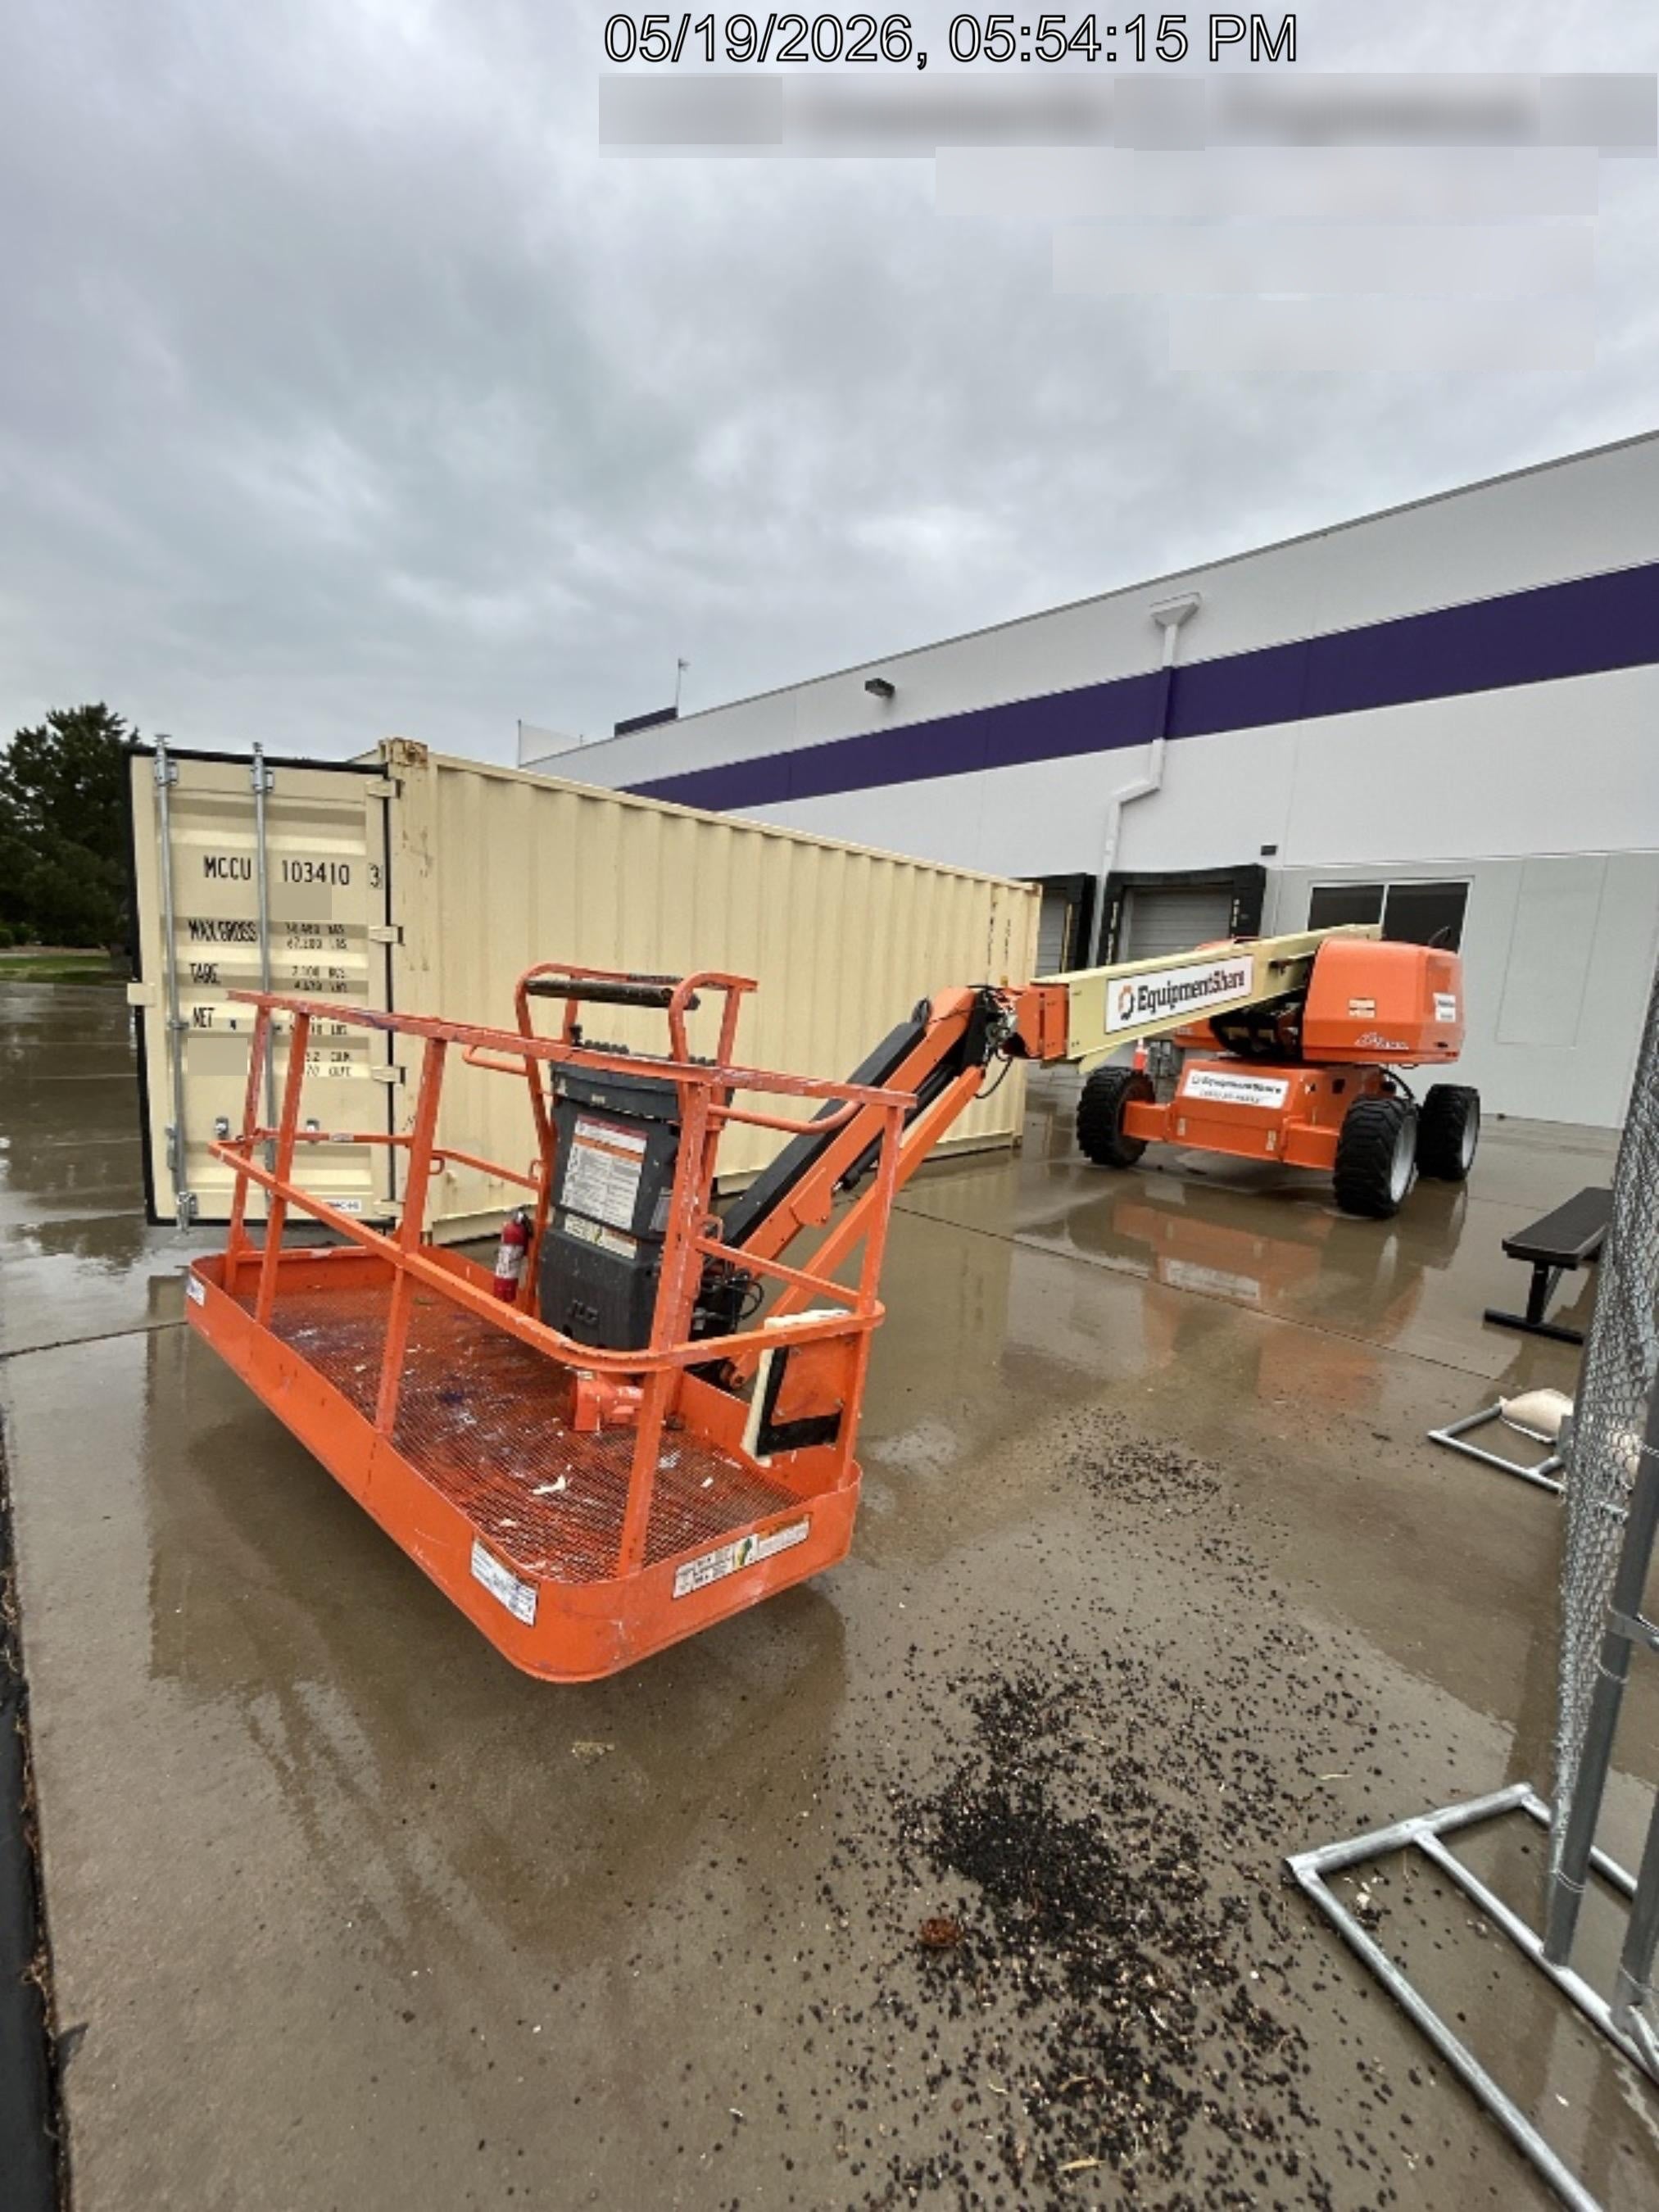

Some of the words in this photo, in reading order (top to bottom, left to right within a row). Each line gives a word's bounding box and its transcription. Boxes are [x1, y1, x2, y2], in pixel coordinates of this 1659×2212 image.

[203, 856, 252, 881] MCCU
[283, 860, 350, 886] 103410
[370, 863, 380, 888] 3
[1138, 969, 1244, 1014] EquipmentShare
[193, 1007, 215, 1028] NET
